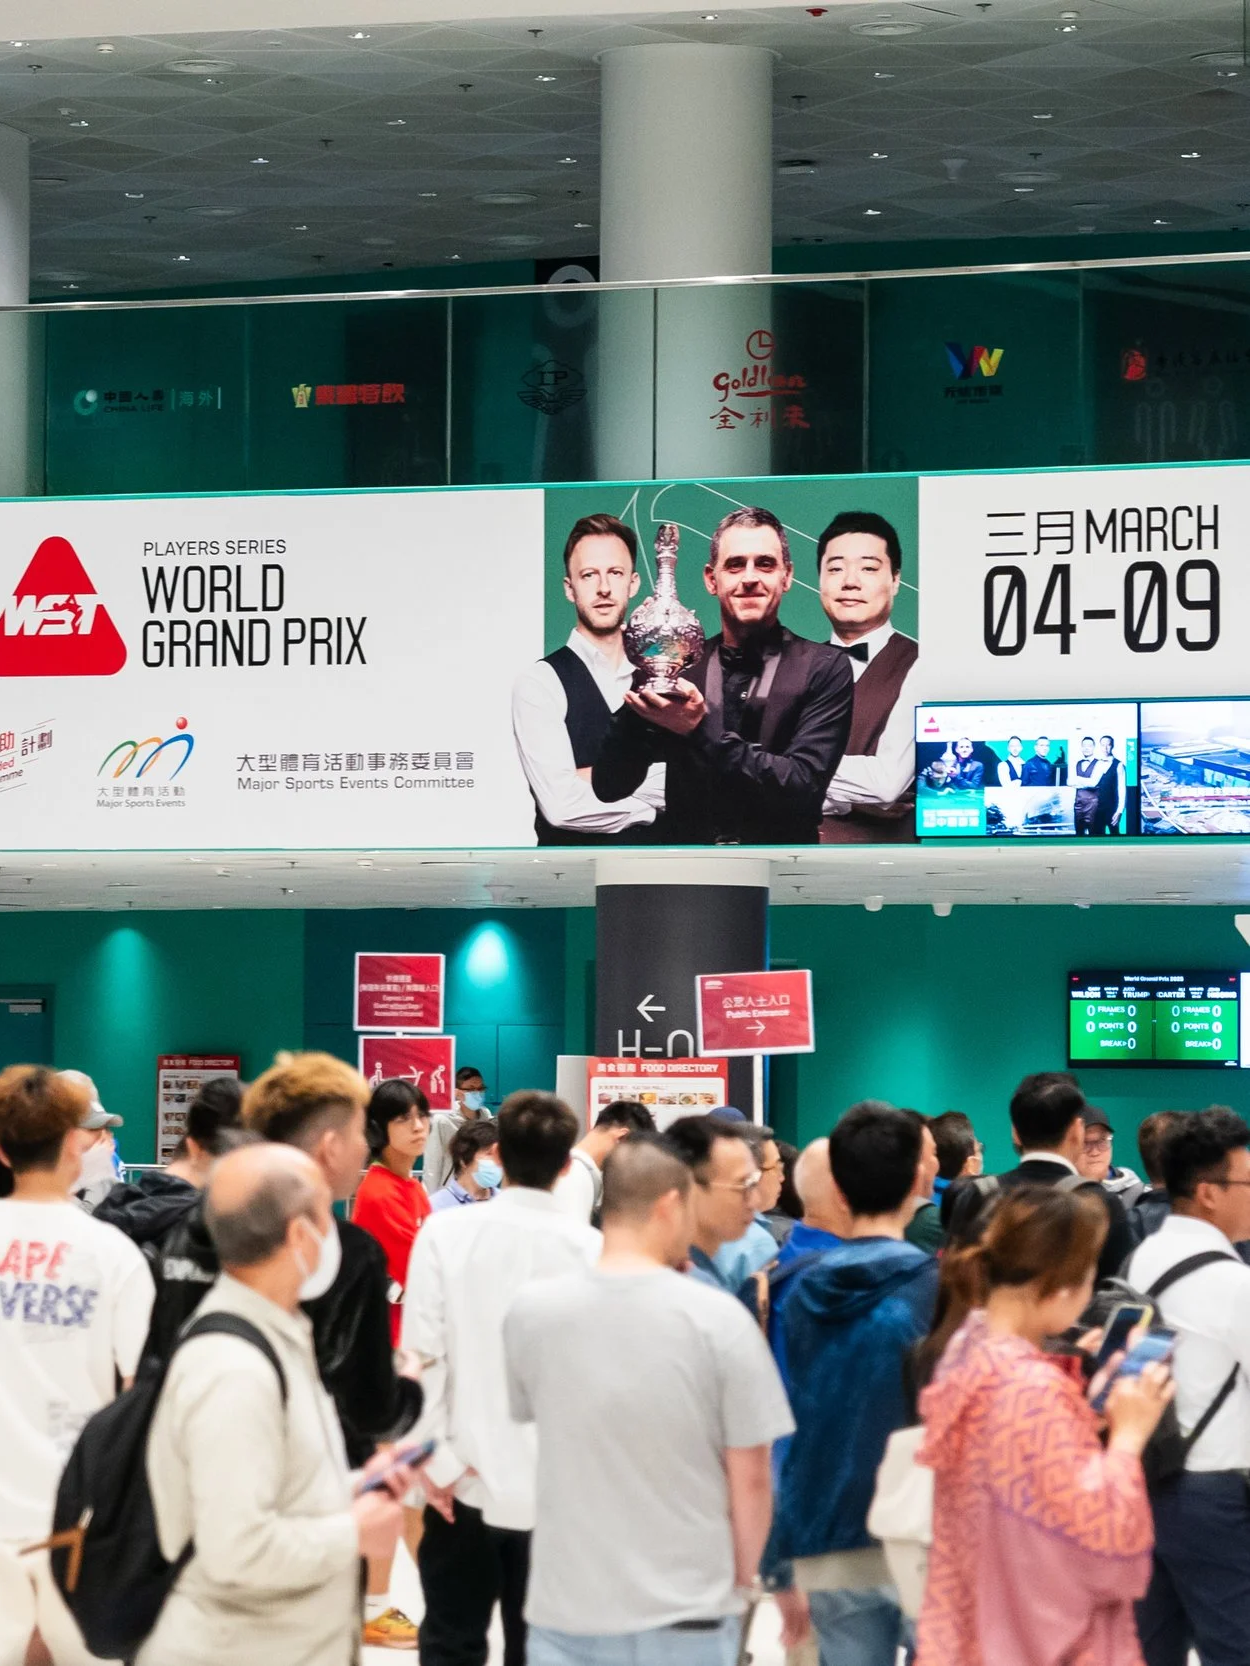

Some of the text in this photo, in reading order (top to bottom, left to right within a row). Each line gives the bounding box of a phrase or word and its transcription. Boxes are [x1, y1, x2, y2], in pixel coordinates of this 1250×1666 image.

[985, 504, 1219, 557] 三月 MARCH
[143, 539, 287, 556] PLAYERS SERIES
[142, 564, 285, 614] WORLD
[984, 559, 1220, 656] 04-09
[142, 617, 367, 667] GRAND PRIX
[236, 751, 474, 772] 大型體育活動事務委員會
[237, 776, 474, 792] Major Sports Events Committee
[96, 799, 186, 809] Major Sports Events
[725, 1010, 751, 1018] Public
[640, 1063, 666, 1073] FOOD
[667, 1063, 719, 1073] DIRECTORY
